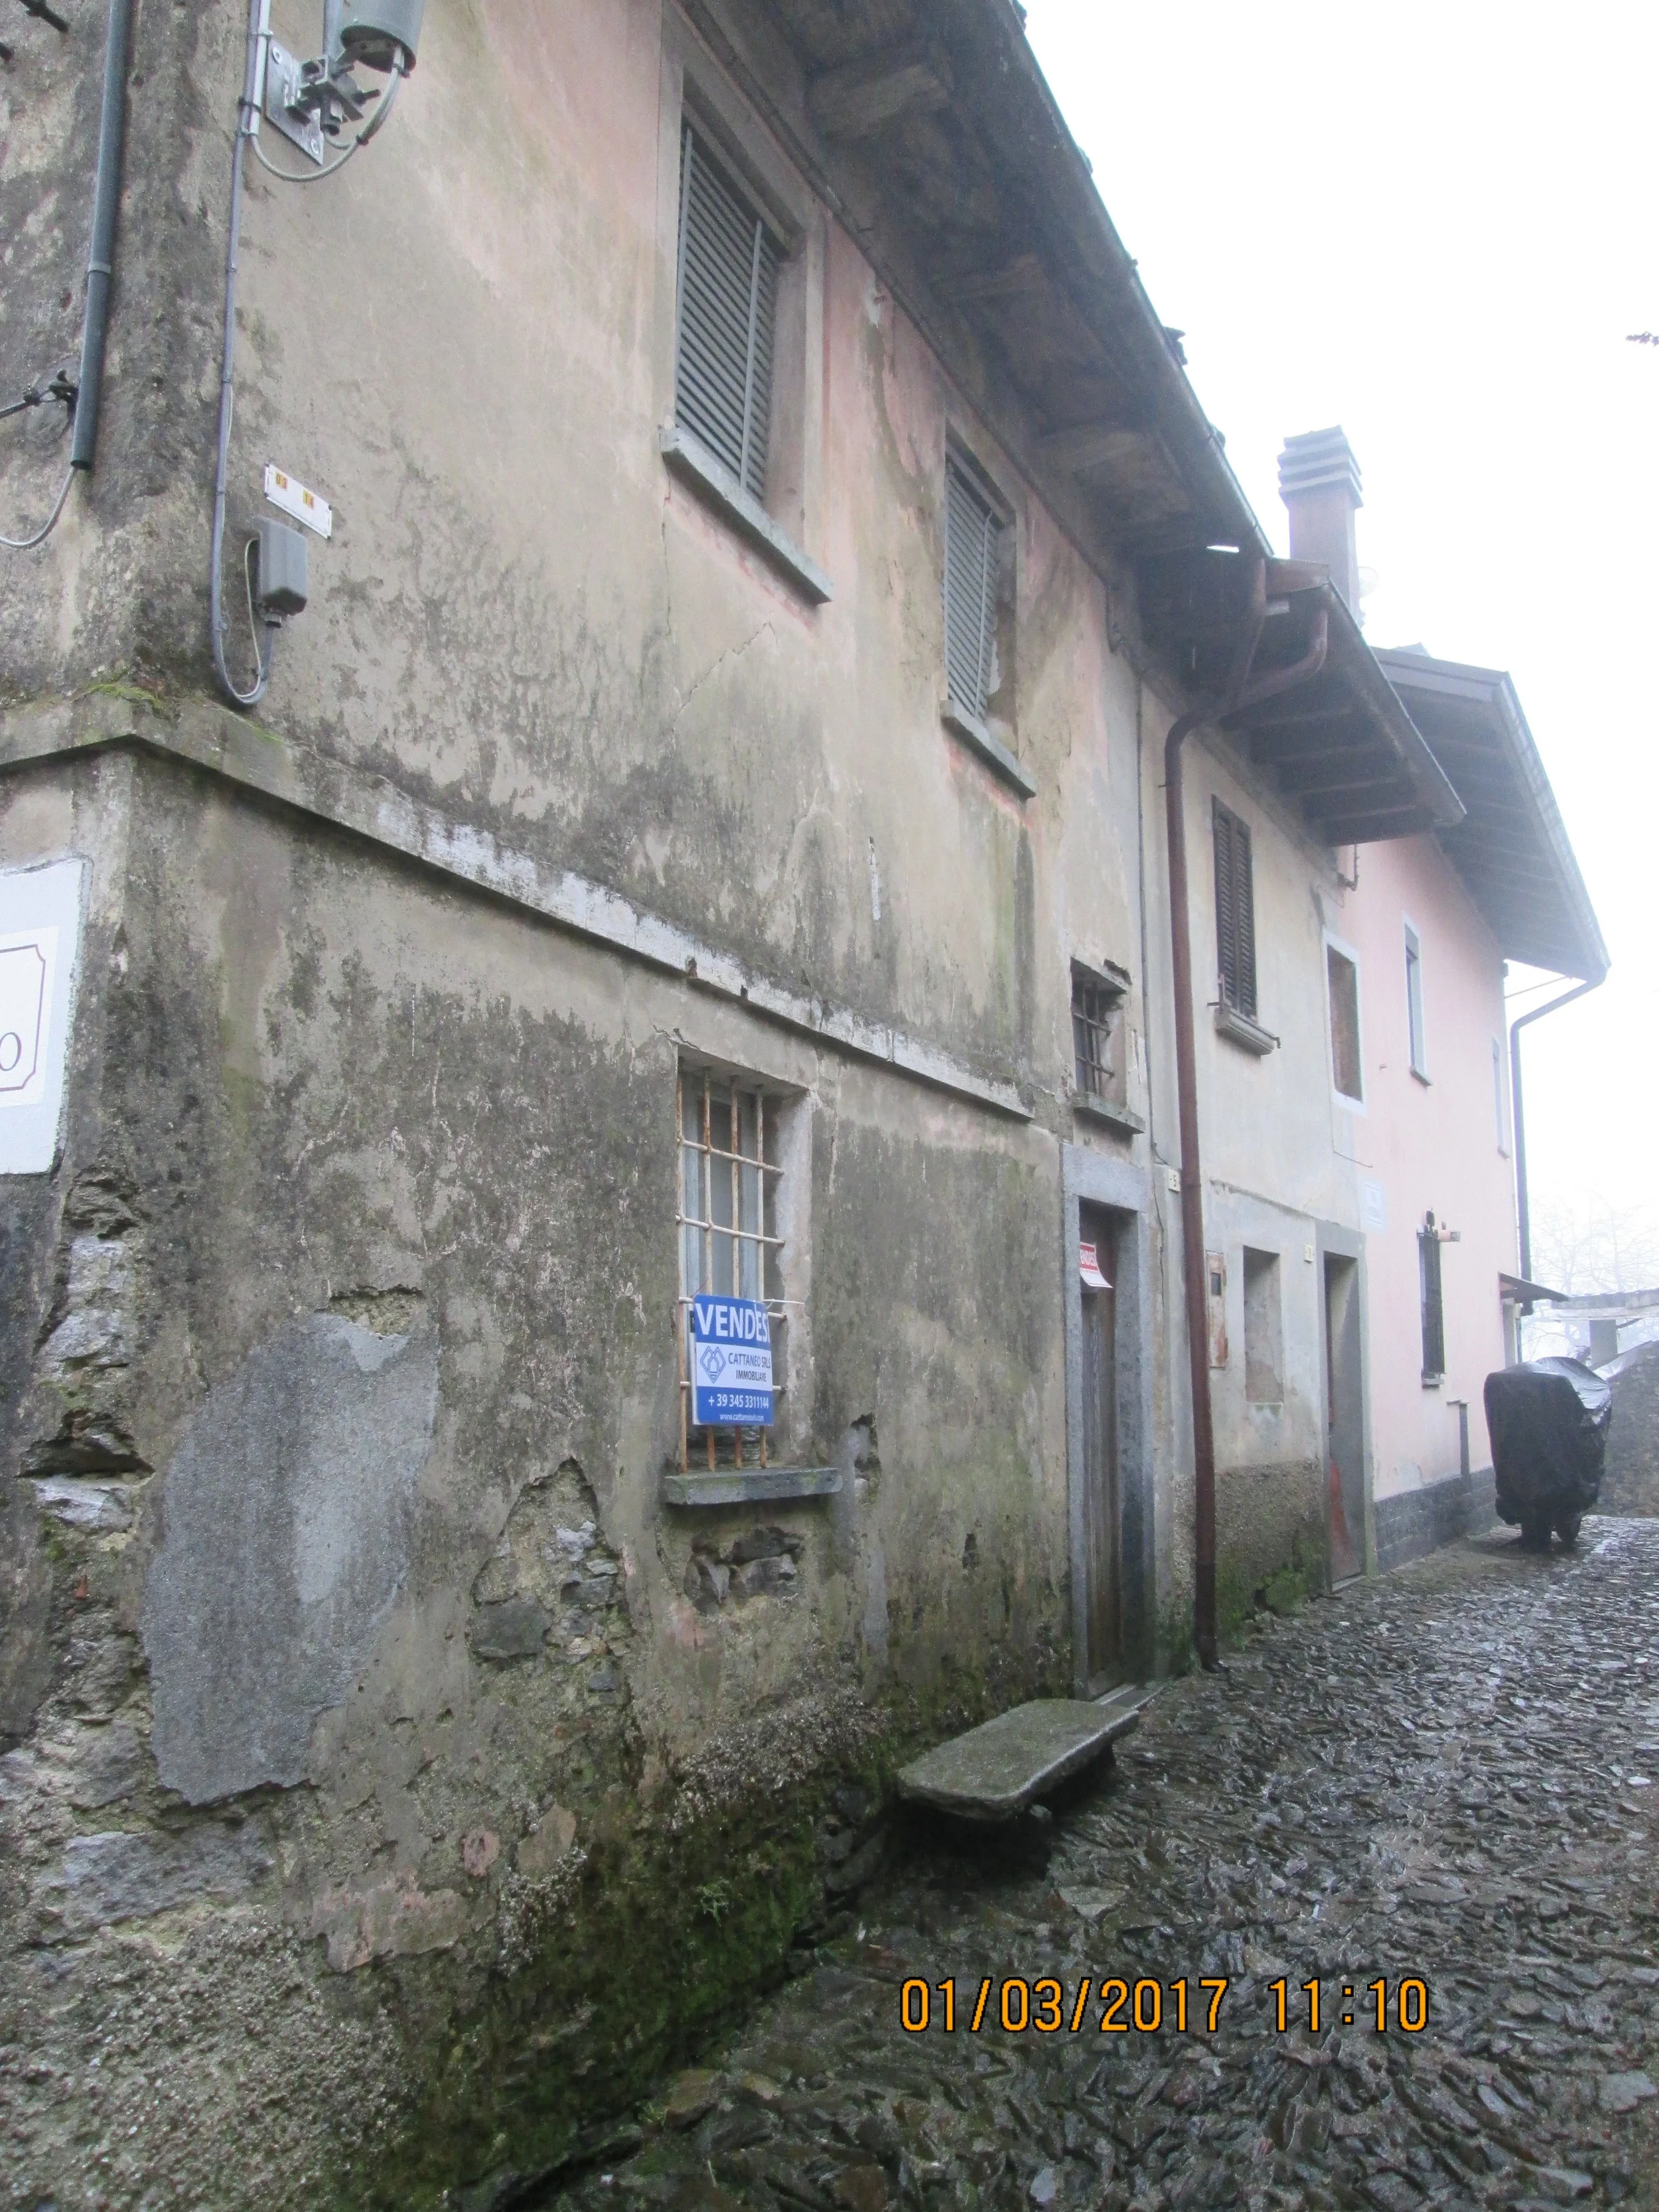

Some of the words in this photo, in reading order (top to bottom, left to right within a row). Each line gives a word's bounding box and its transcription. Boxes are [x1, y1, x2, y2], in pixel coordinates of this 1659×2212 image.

[694, 1303, 770, 1343] VENDESI
[728, 1353, 760, 1367] CATTANEO
[736, 1369, 766, 1382] IMMOBILIARE
[717, 1394, 728, 1407] 39
[729, 1394, 744, 1408] 345
